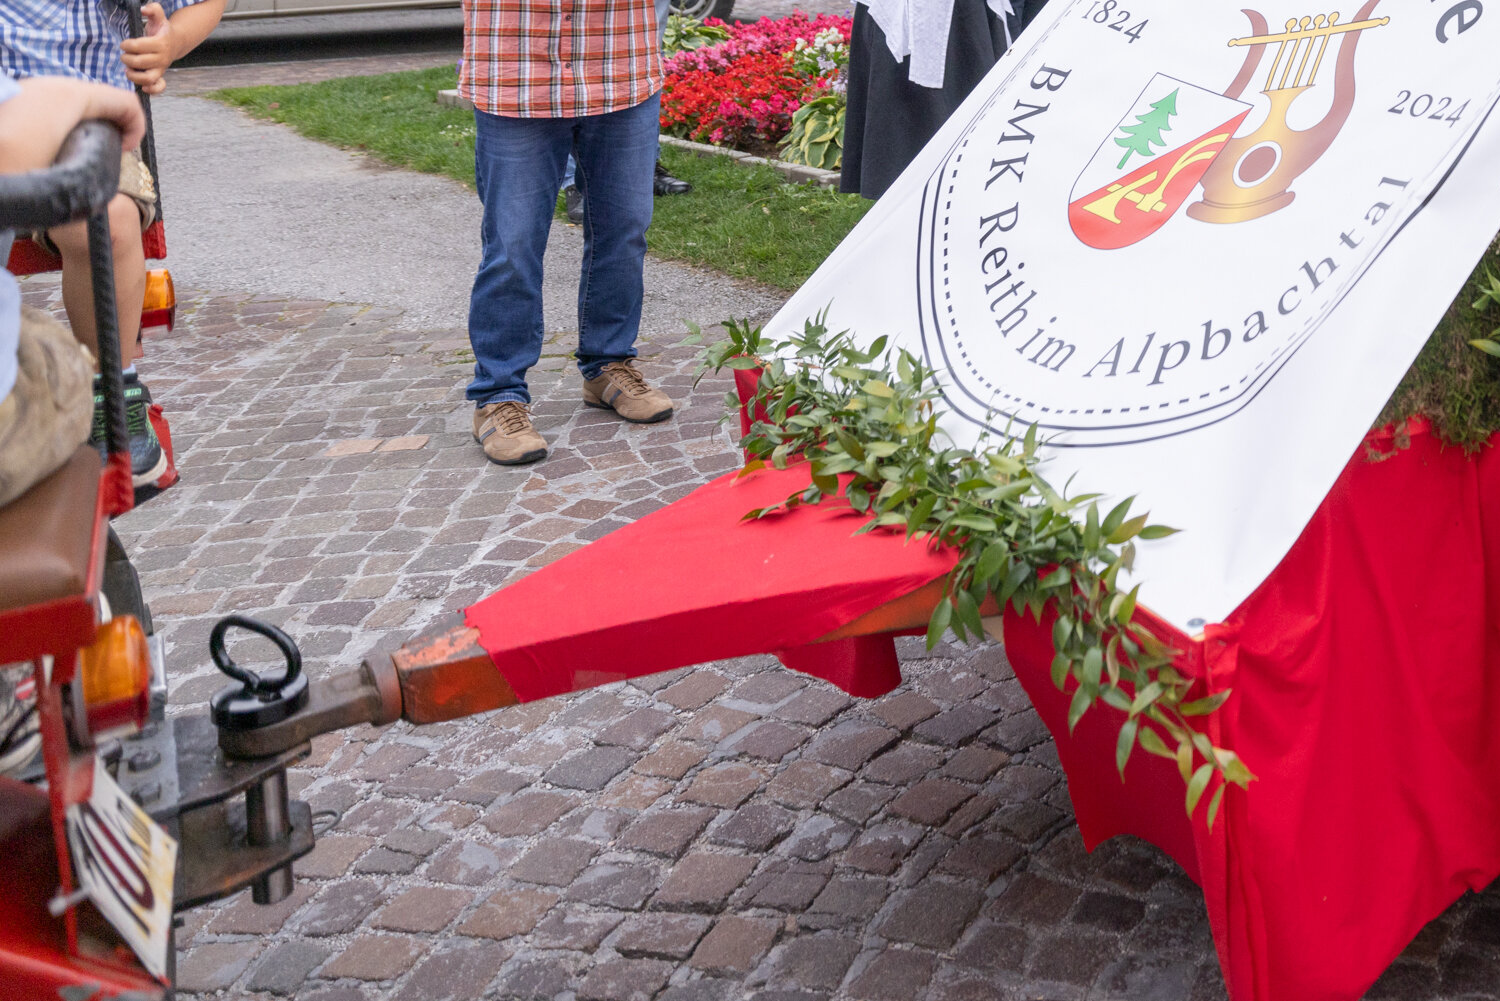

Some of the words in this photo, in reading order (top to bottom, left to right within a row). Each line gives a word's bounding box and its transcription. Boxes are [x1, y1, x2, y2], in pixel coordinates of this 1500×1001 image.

[1081, 0, 1150, 44] 1824
[983, 62, 1073, 192] BMK
[1387, 89, 1472, 129] 2024
[978, 201, 1039, 339] Reith
[1081, 174, 1412, 387] Alpbachtal
[1016, 318, 1078, 374] im
